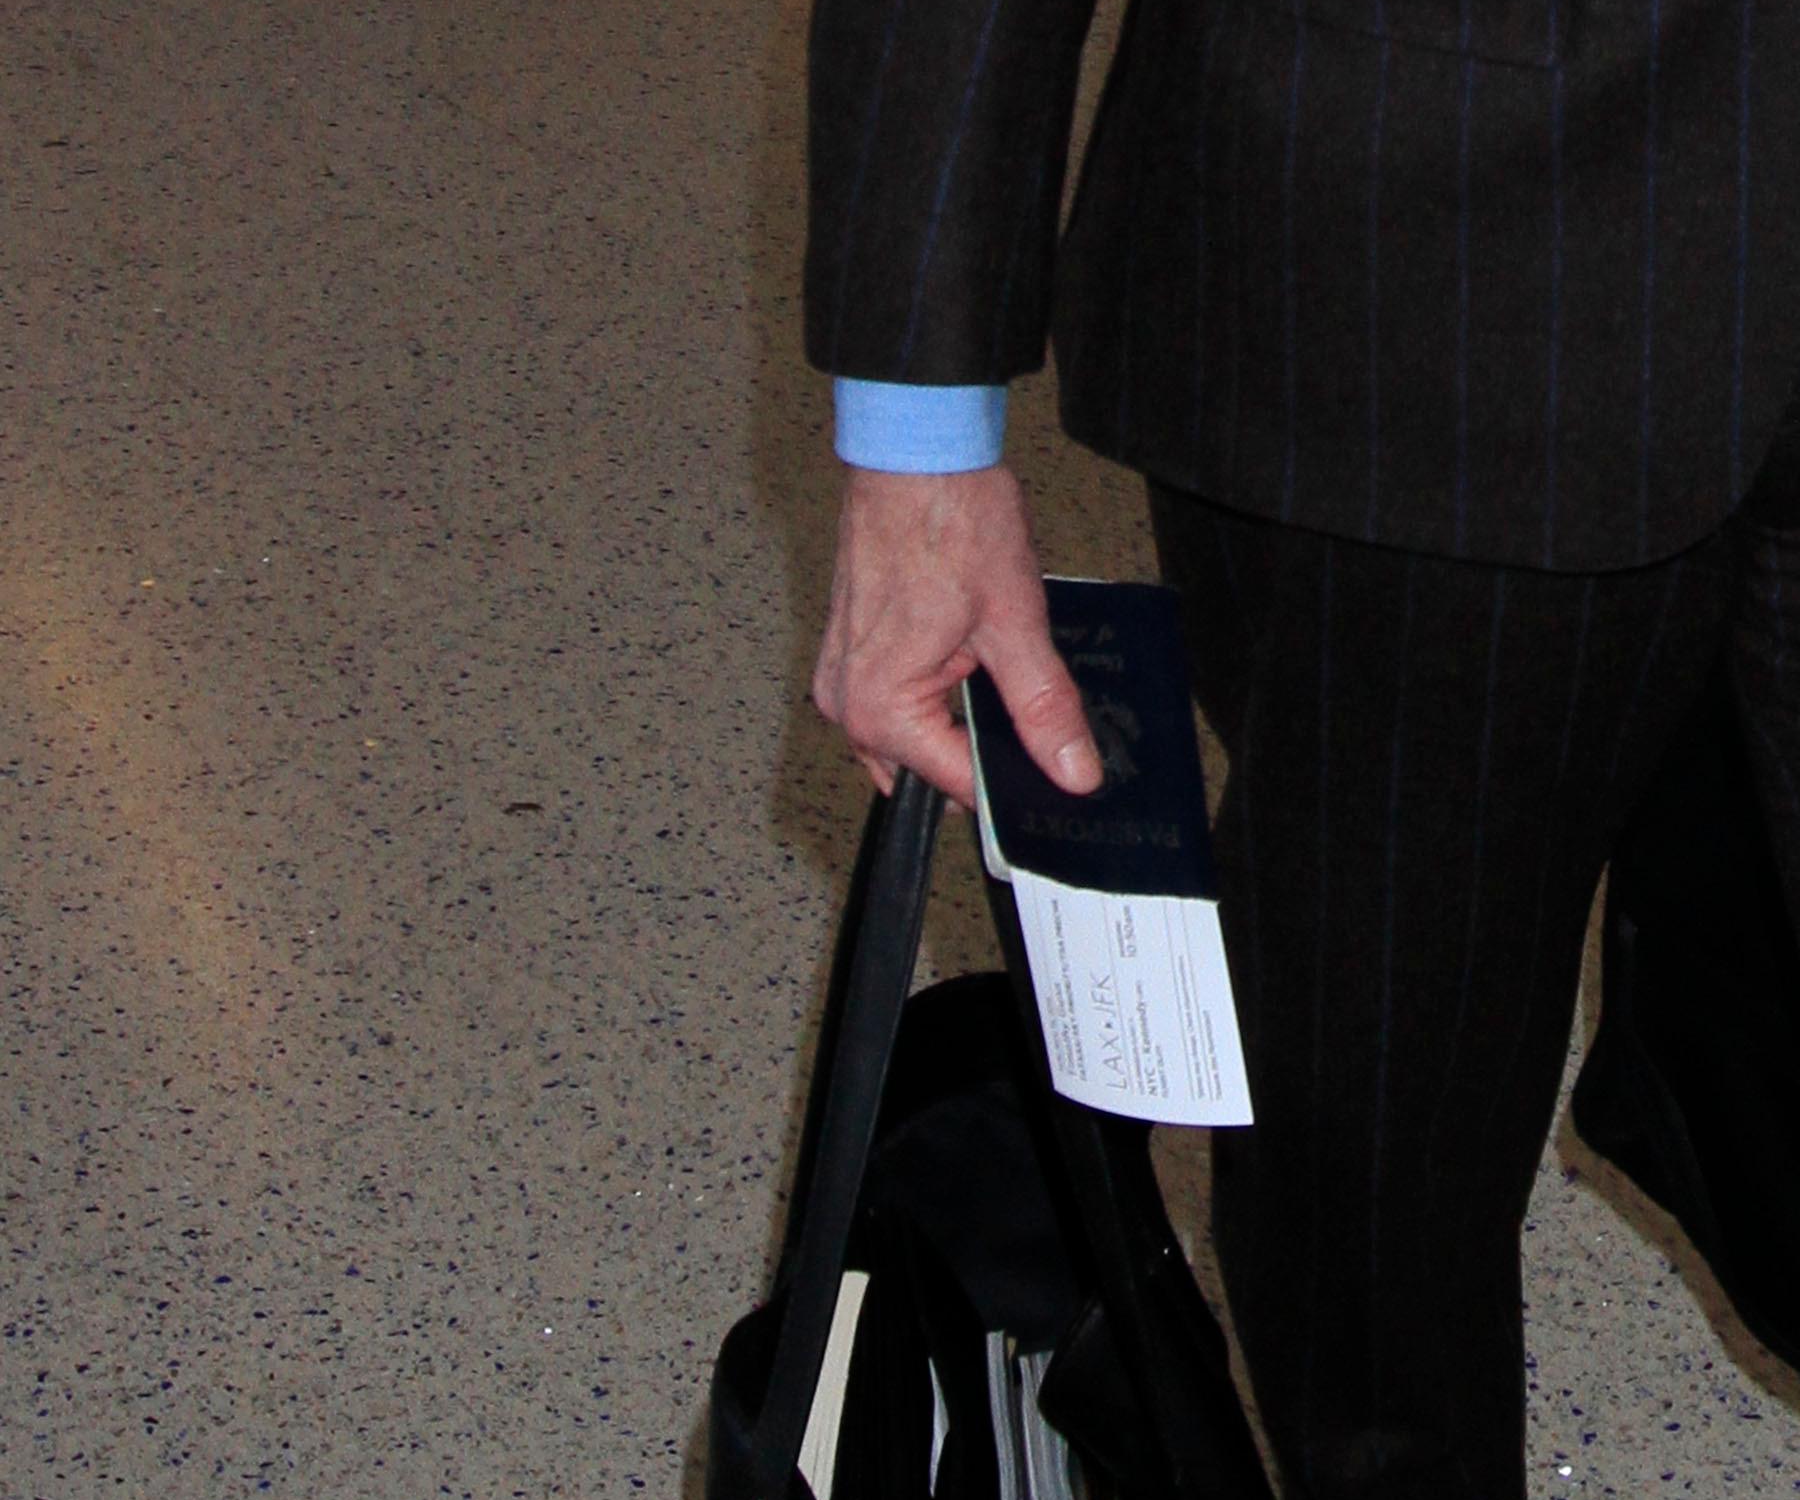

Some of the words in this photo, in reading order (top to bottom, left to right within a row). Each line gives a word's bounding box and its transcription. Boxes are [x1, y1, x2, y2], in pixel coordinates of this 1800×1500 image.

[1088, 969, 1117, 1018] JFK
[1097, 1033, 1128, 1091] LAX
[1143, 1067, 1159, 1097] NYC
